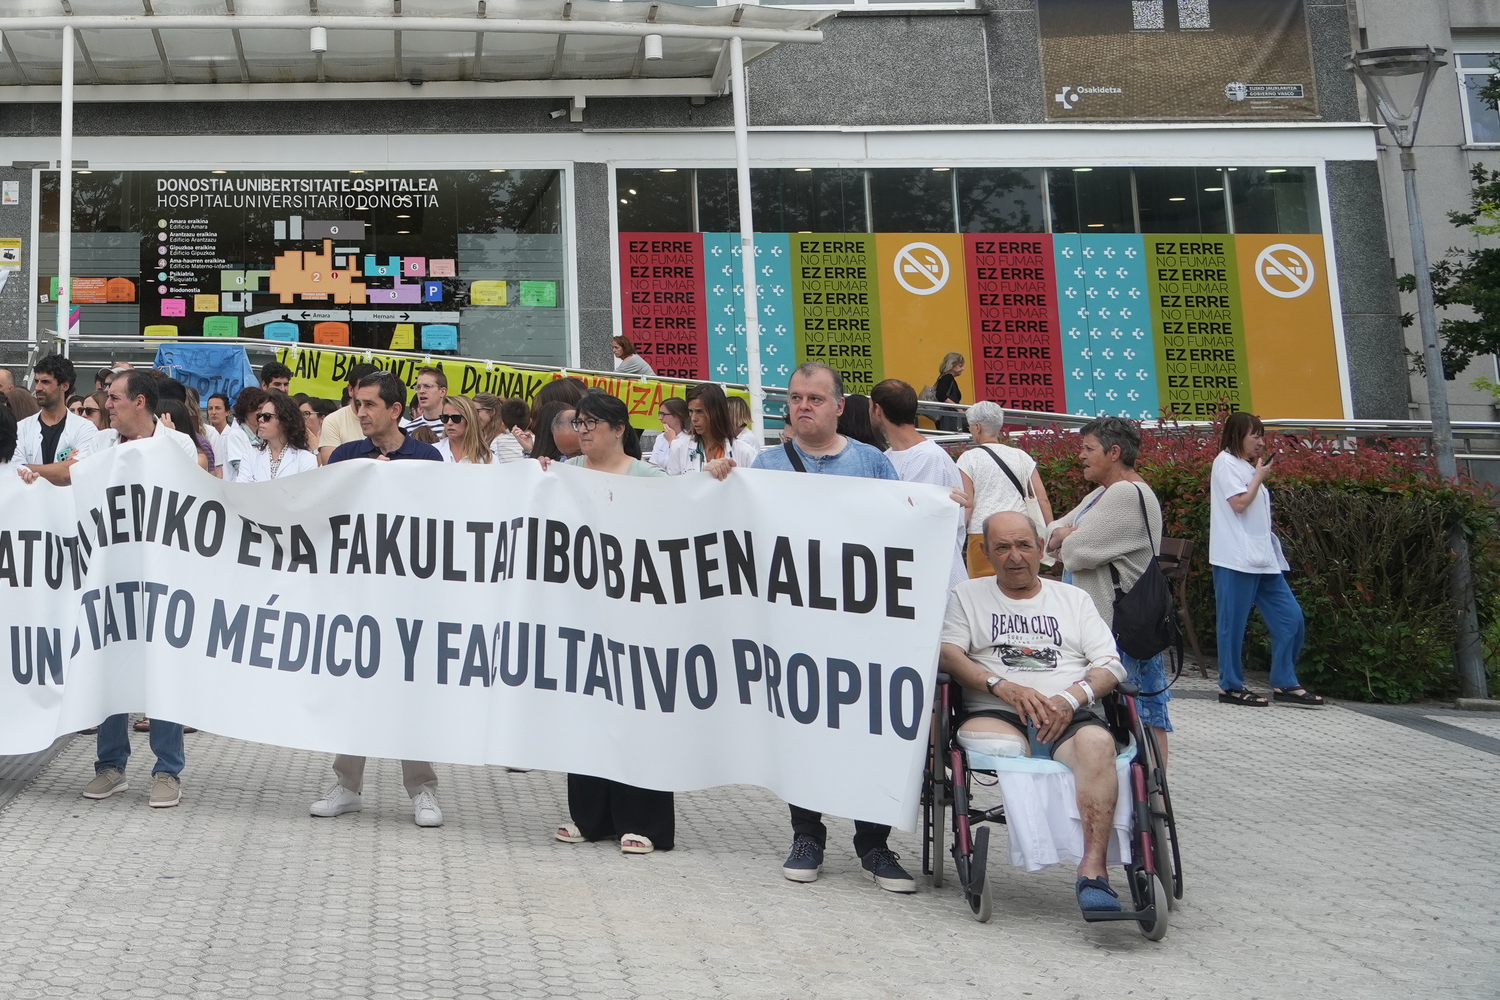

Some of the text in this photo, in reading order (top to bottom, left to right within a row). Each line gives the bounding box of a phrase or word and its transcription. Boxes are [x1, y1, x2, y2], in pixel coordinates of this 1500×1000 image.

[1077, 86, 1122, 94] Osakidetza
[157, 178, 438, 192] DONOSTIA UNIBERTSITATE OSPITALEA
[157, 194, 439, 208] HOSPITAL UNIVERSITARIO DONOSTIA
[629, 241, 693, 253] EZ ERRE
[800, 241, 865, 253] EZ ERRE
[975, 242, 1043, 254] EZ ERRE
[1155, 243, 1224, 255] EZ ERRE
[630, 254, 694, 265] NO FUMAR
[801, 255, 866, 265] NO FUMAR
[976, 256, 1044, 266] NO FUMAR
[1156, 256, 1226, 267] NO FUMAR
[1158, 269, 1227, 281] EZ ERRE
[429, 286, 438, 297] P
[237, 514, 318, 574] ETA
[767, 536, 916, 620] ALDE
[991, 613, 1062, 646] BEACH CLUB
[11, 625, 64, 687] UN
[206, 593, 381, 680] MÉDICO
[395, 617, 423, 682] Y
[437, 620, 718, 713] FACULTATIVO
[731, 638, 925, 741] PROPIO
